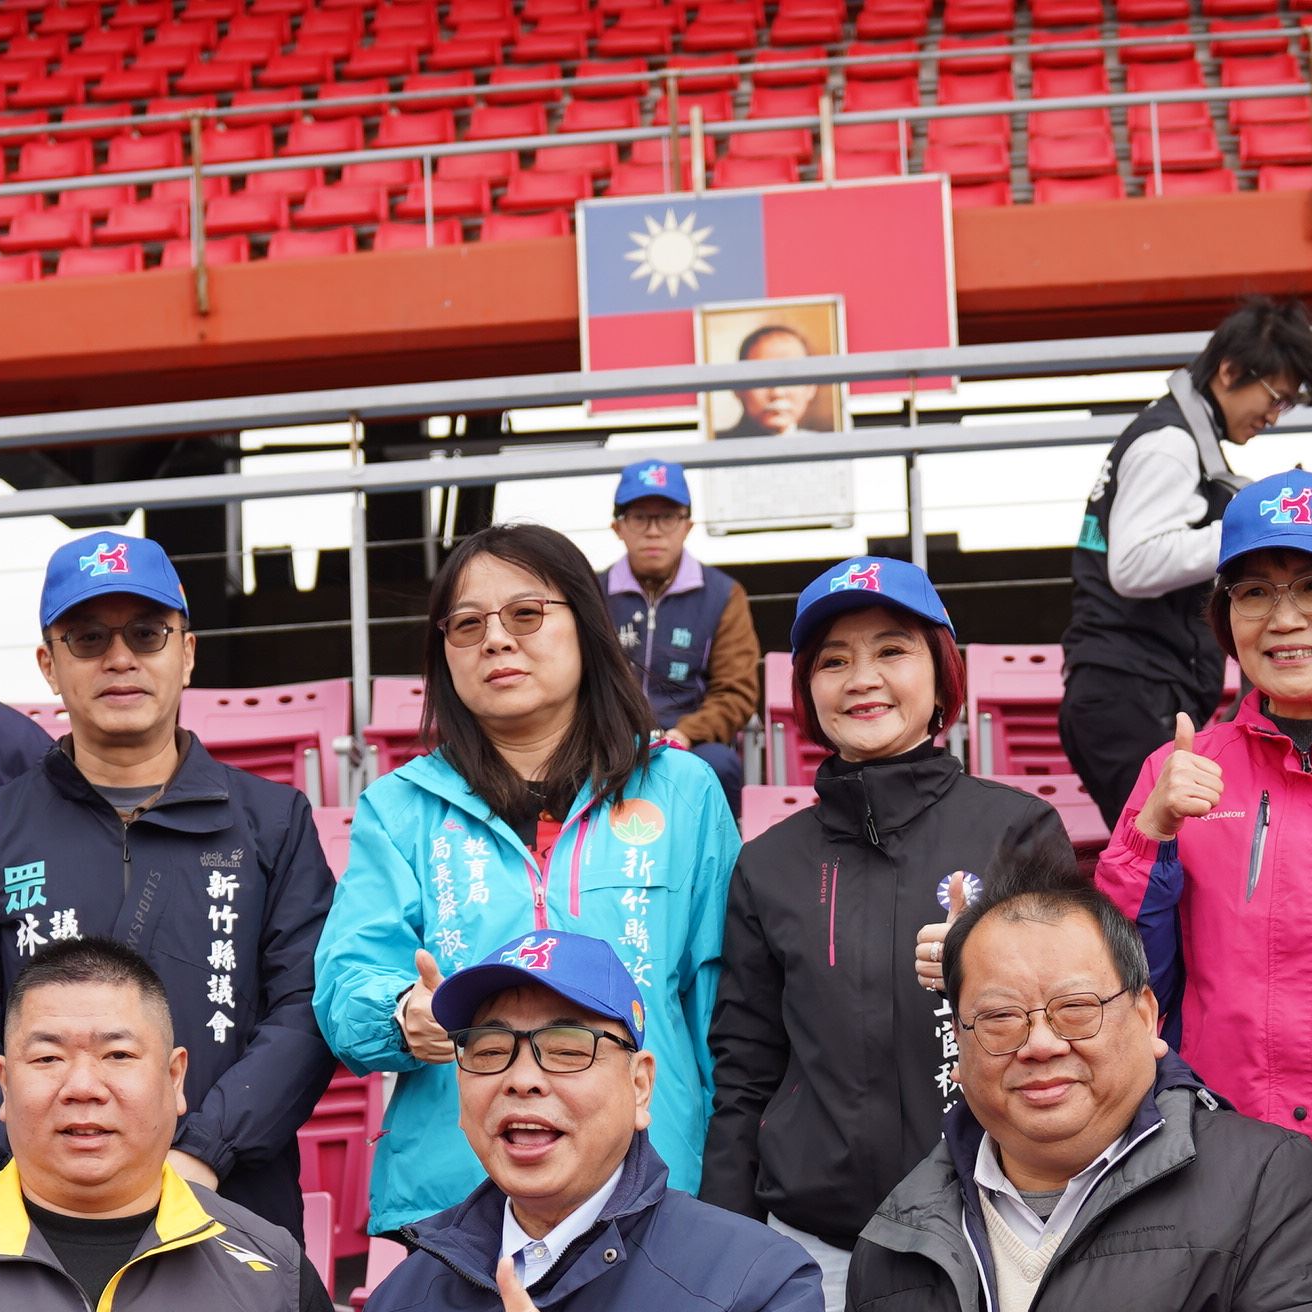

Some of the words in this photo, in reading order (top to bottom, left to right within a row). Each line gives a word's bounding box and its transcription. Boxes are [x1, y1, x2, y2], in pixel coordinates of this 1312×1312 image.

[3, 860, 47, 914] 眾
[430, 836, 469, 972] 局長蔡淑
[463, 836, 491, 906] 教育局
[205, 870, 240, 1044] 新竹縣議會
